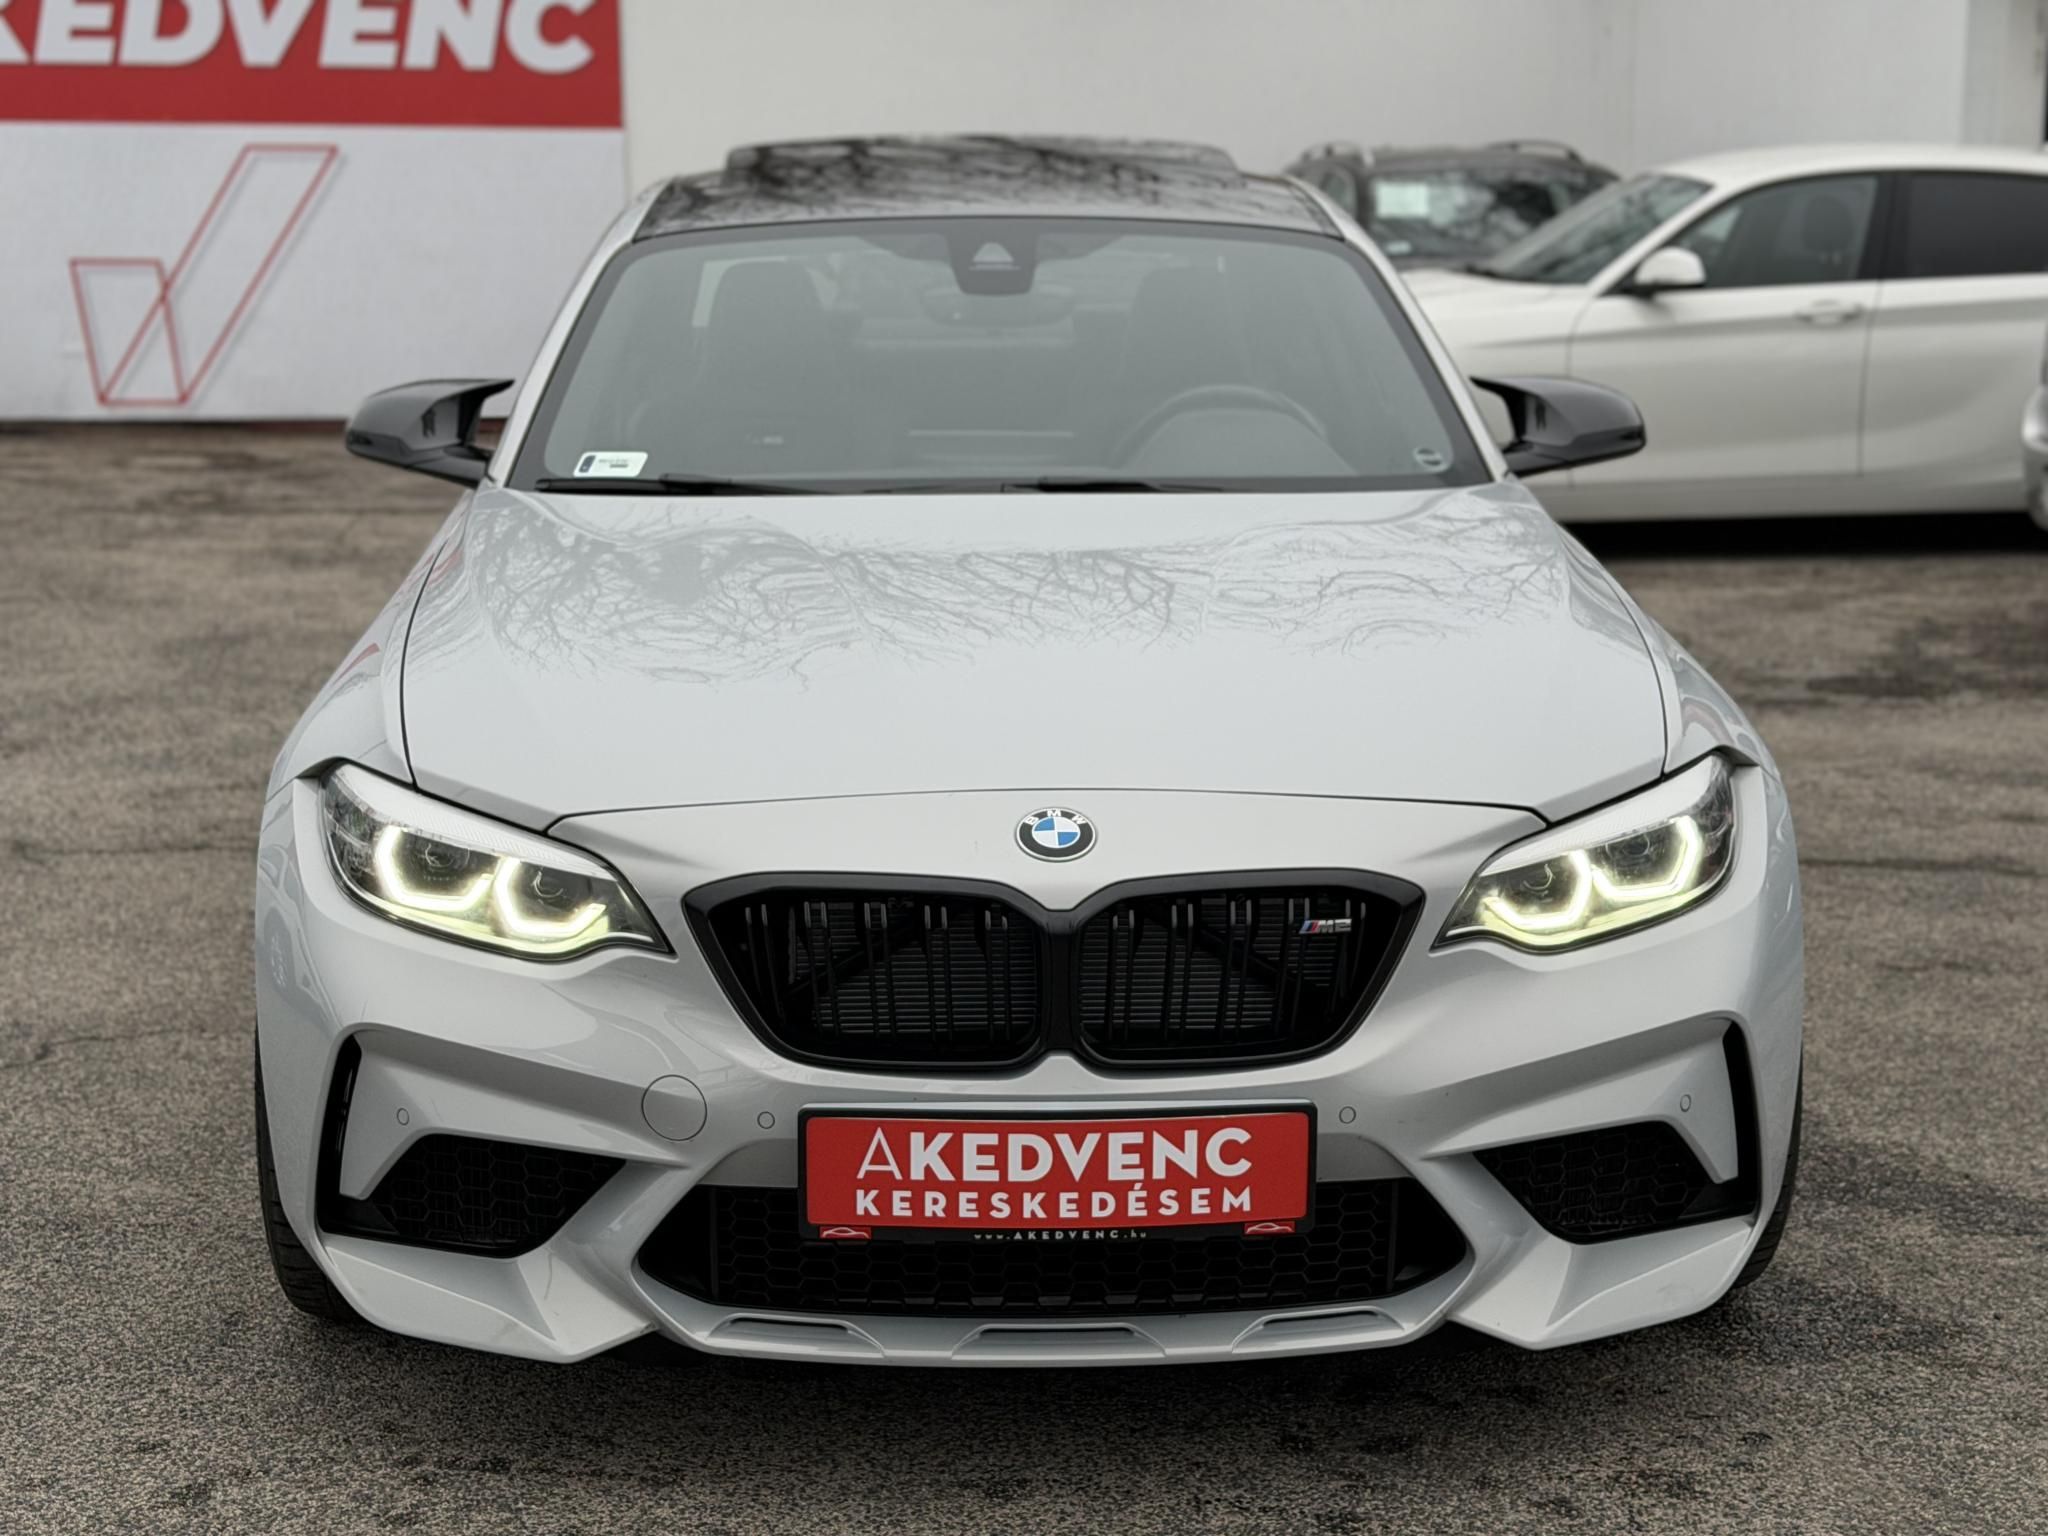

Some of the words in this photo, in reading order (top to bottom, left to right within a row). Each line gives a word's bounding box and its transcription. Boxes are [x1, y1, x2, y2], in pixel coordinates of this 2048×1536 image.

[0, 0, 594, 74] EDVENC
[1023, 807, 1087, 825] BMW
[856, 1127, 1252, 1182] AKEDVENC
[856, 1183, 1251, 1219] KERESKEDÉSEM
[973, 1229, 1147, 1241] www.AKEDVENC.hu
